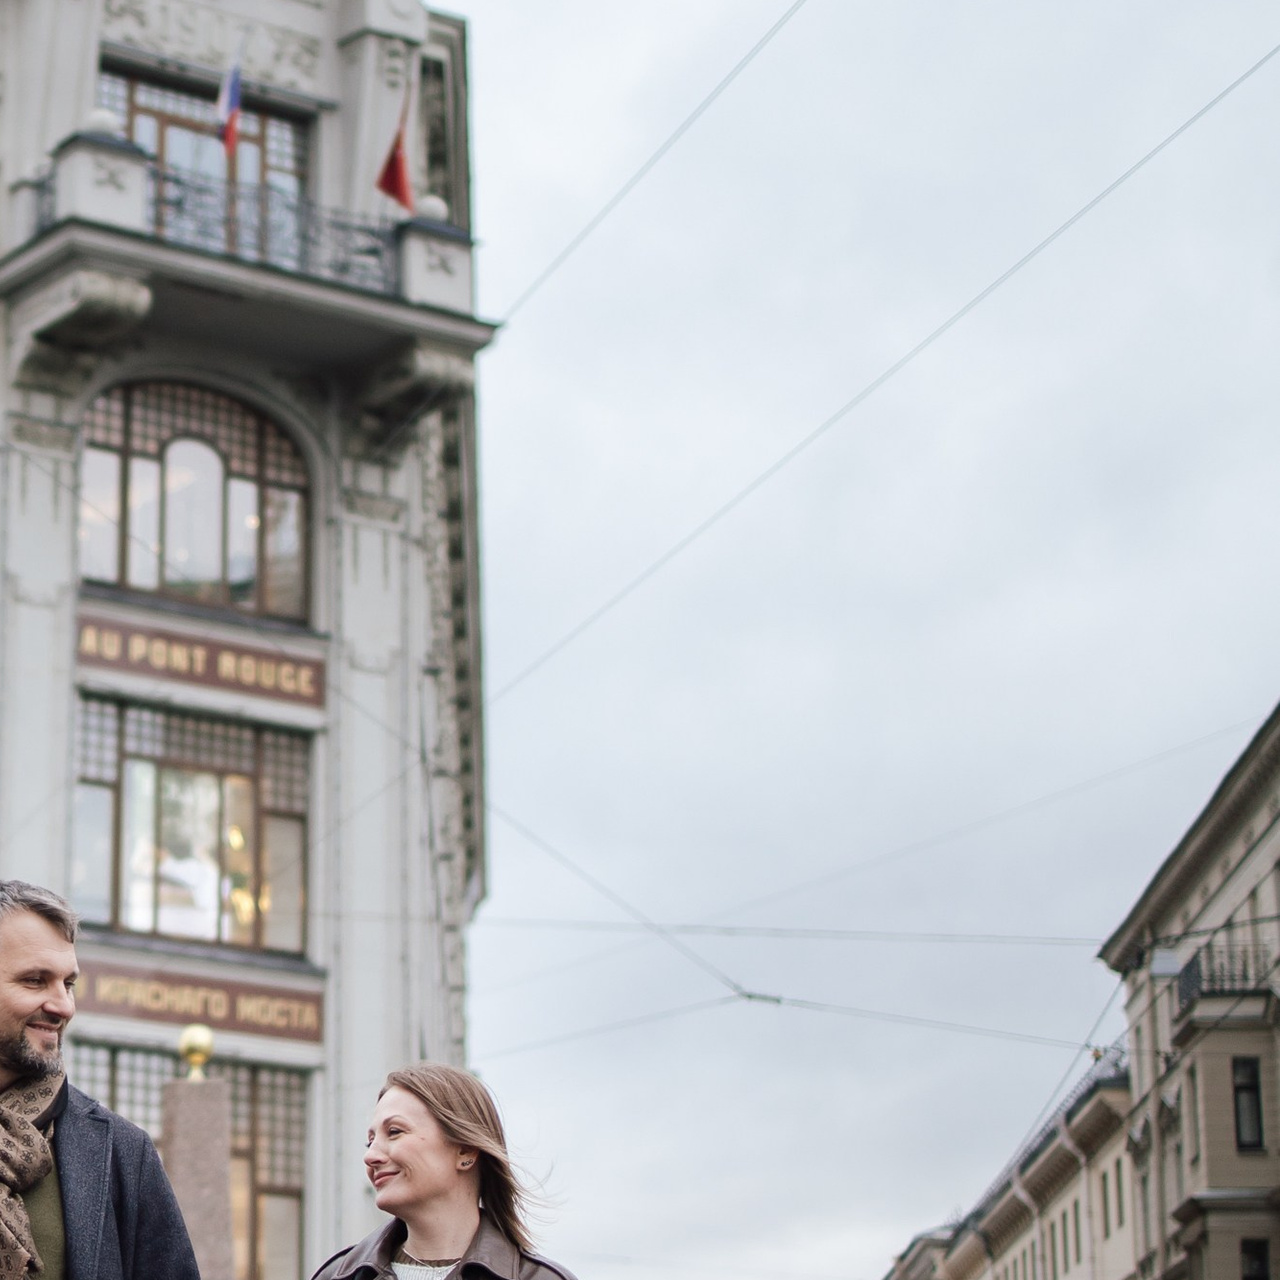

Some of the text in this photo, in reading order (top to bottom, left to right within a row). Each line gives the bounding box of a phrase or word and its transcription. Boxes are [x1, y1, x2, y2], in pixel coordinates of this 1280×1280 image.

[80, 625, 316, 698] AU PONT ROUGE
[96, 976, 230, 1022] КРАСНАГО
[236, 994, 320, 1032] МОСТА
